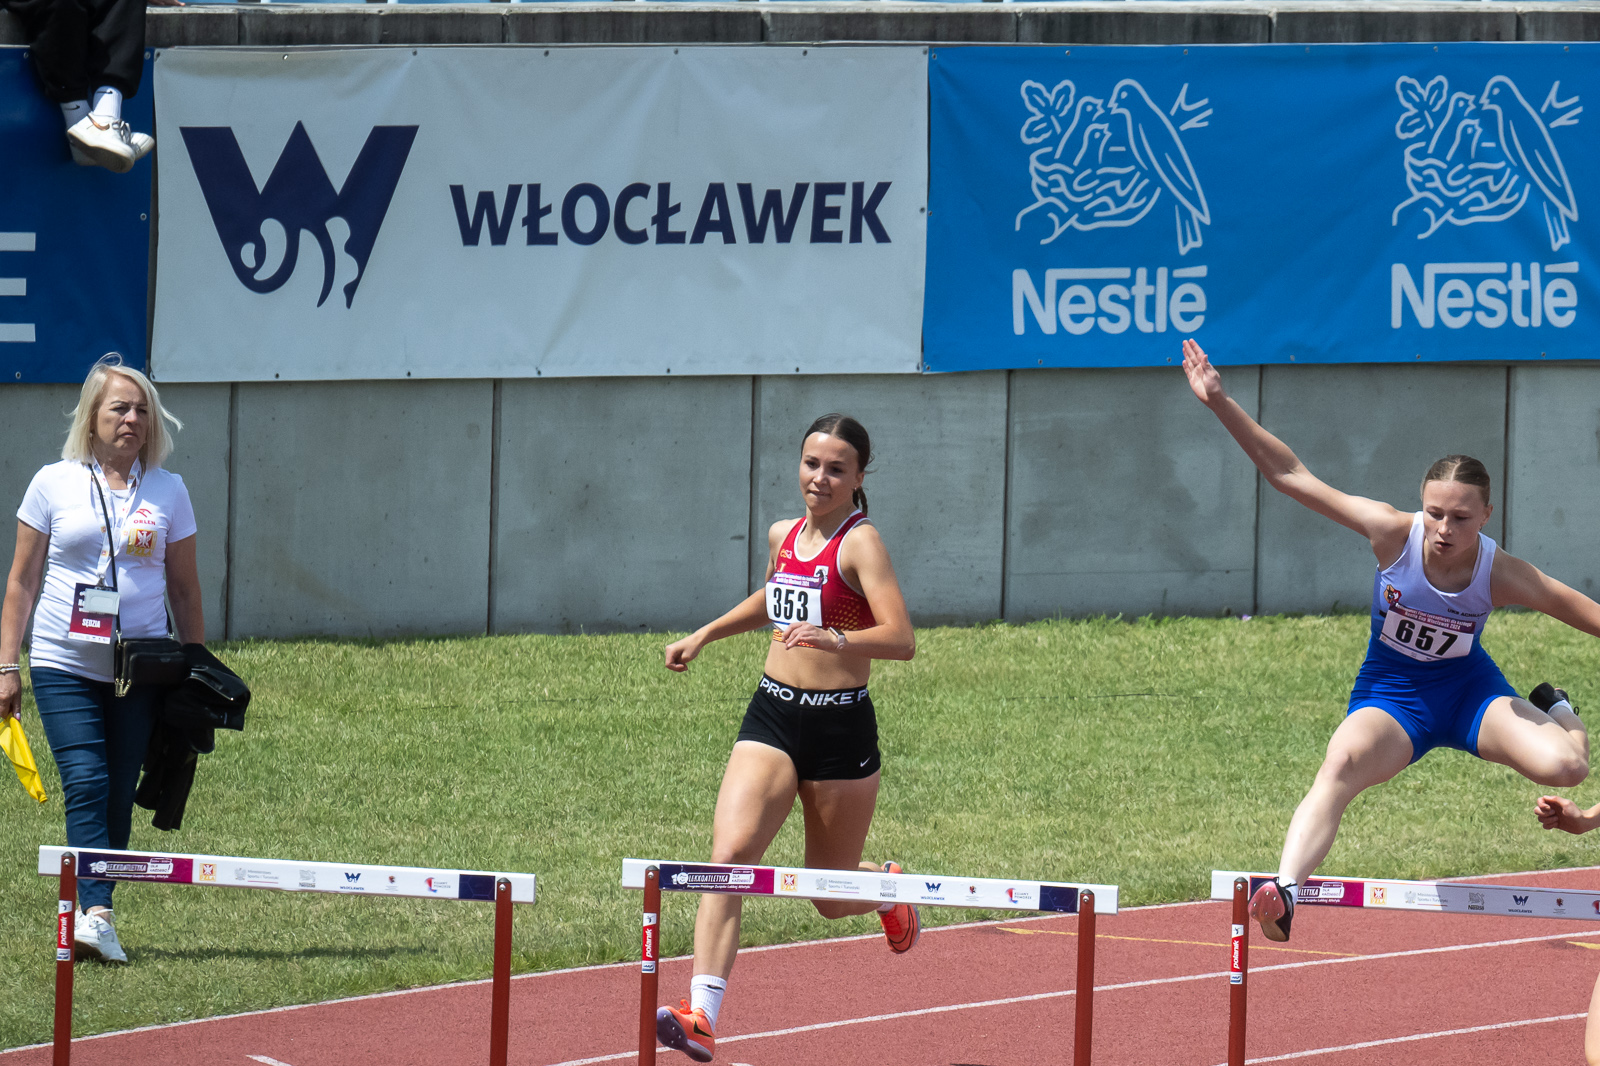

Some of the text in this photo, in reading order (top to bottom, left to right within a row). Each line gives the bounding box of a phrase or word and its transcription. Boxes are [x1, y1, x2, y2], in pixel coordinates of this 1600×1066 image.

[449, 181, 893, 247] WŁOCŁAWEK
[1012, 265, 1208, 336] Nestlé
[1391, 261, 1579, 330] Nestlé
[773, 587, 808, 622] 353
[1395, 618, 1458, 656] 657
[760, 677, 794, 701] PRO
[799, 692, 855, 706] NIKE
[60, 916, 68, 945] polanik
[645, 928, 653, 959] polanik
